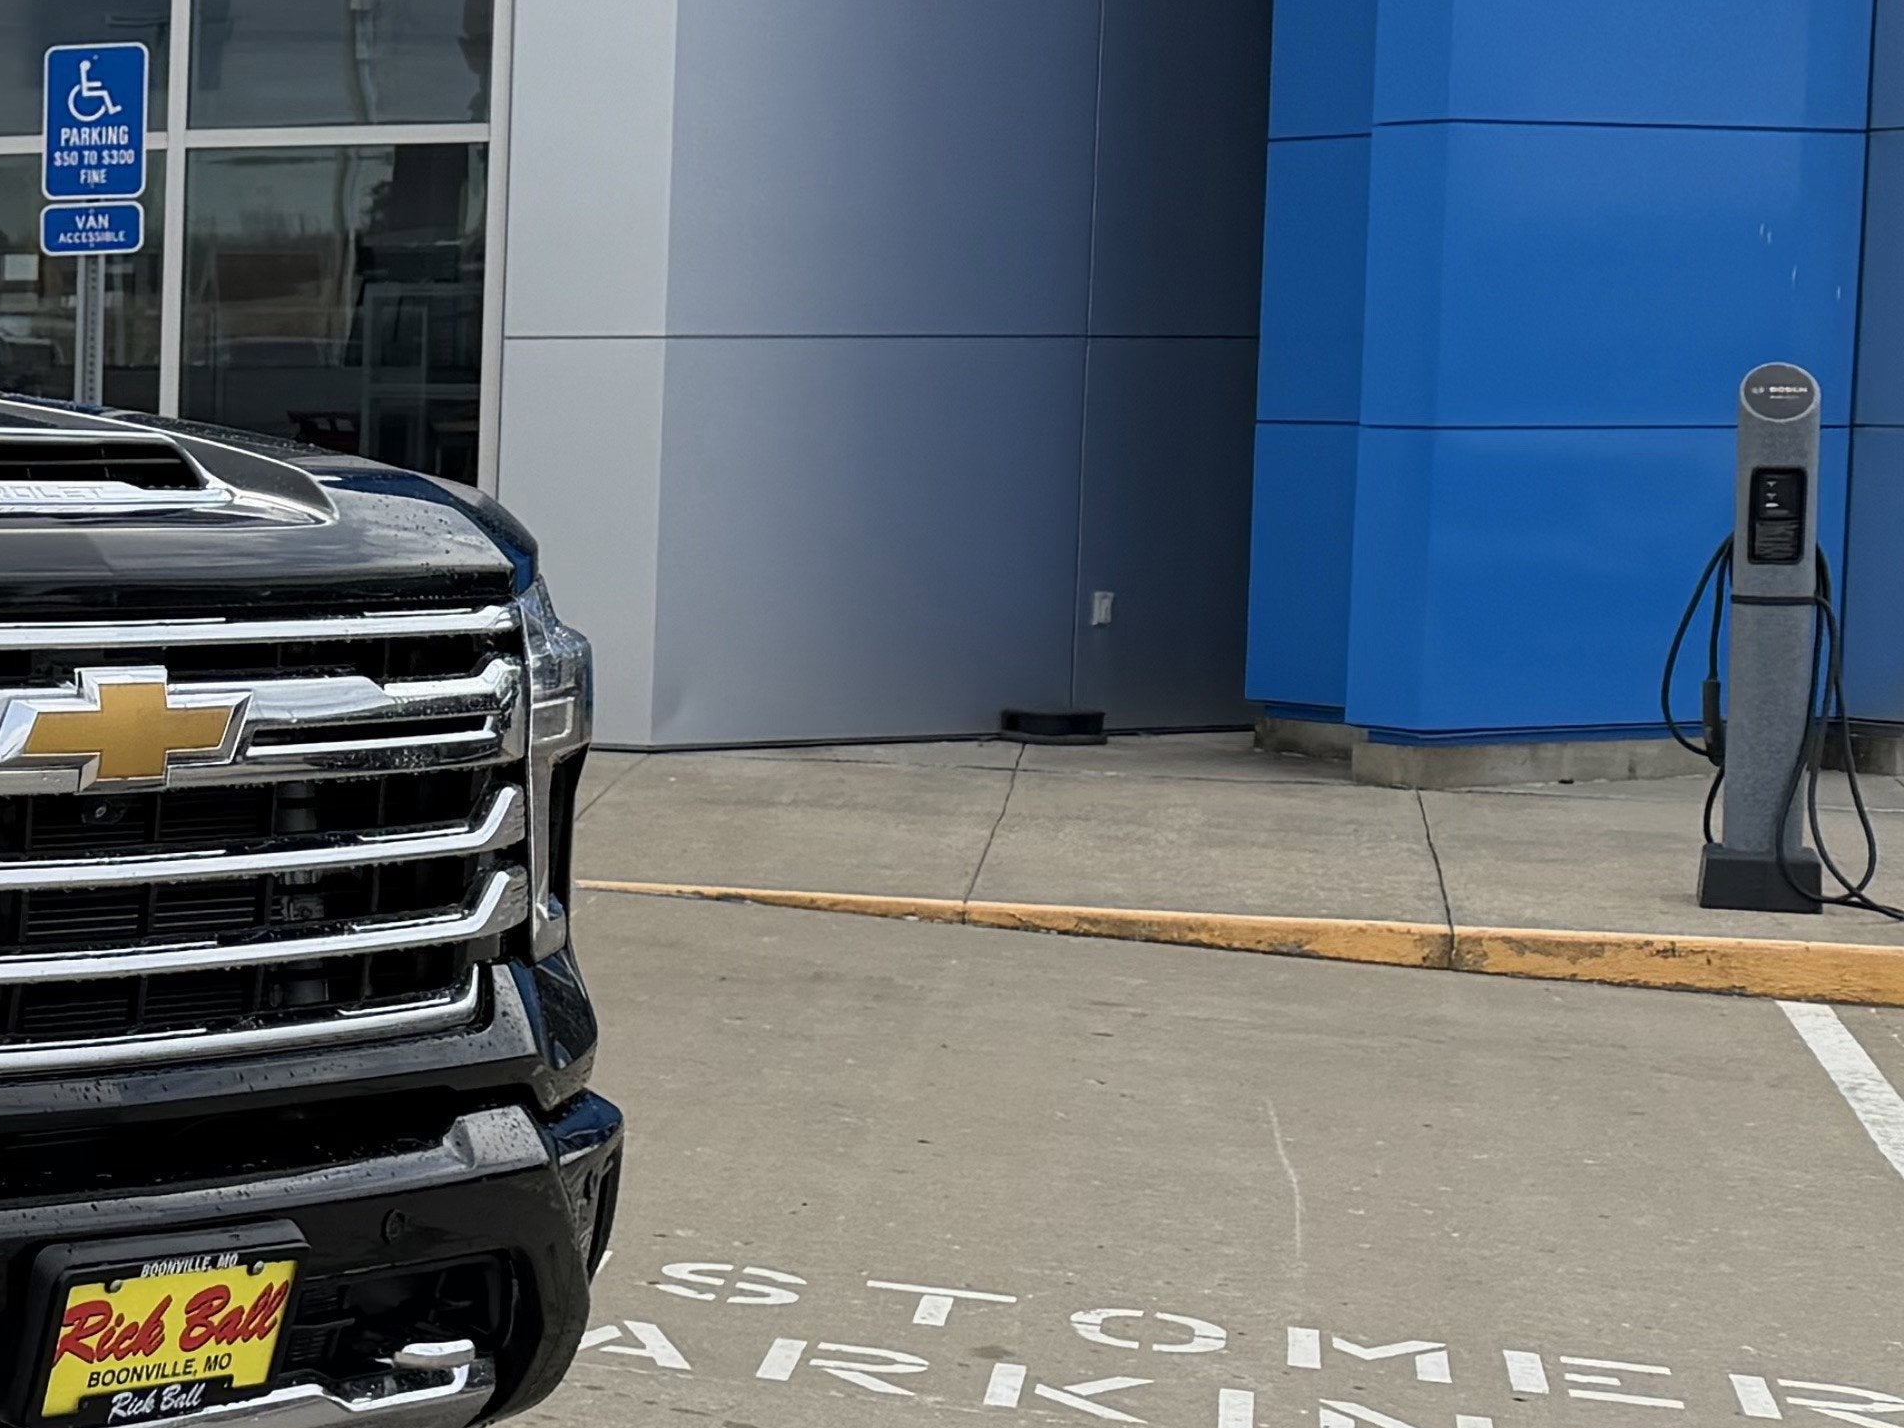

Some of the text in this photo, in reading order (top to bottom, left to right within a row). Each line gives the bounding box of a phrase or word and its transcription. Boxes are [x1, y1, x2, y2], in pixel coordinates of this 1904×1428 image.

[60, 126, 129, 147] PARKING
[54, 149, 135, 166] $50 TO $300
[80, 169, 107, 184] FINE
[76, 214, 109, 229] VAN
[58, 231, 126, 244] ACCESSIBLE
[141, 1253, 238, 1278] BOONVILLE, MO
[54, 1280, 289, 1367] Rick Ball
[87, 1353, 232, 1388] BOONVILLE, MO
[108, 1383, 206, 1424] Rick Ball
